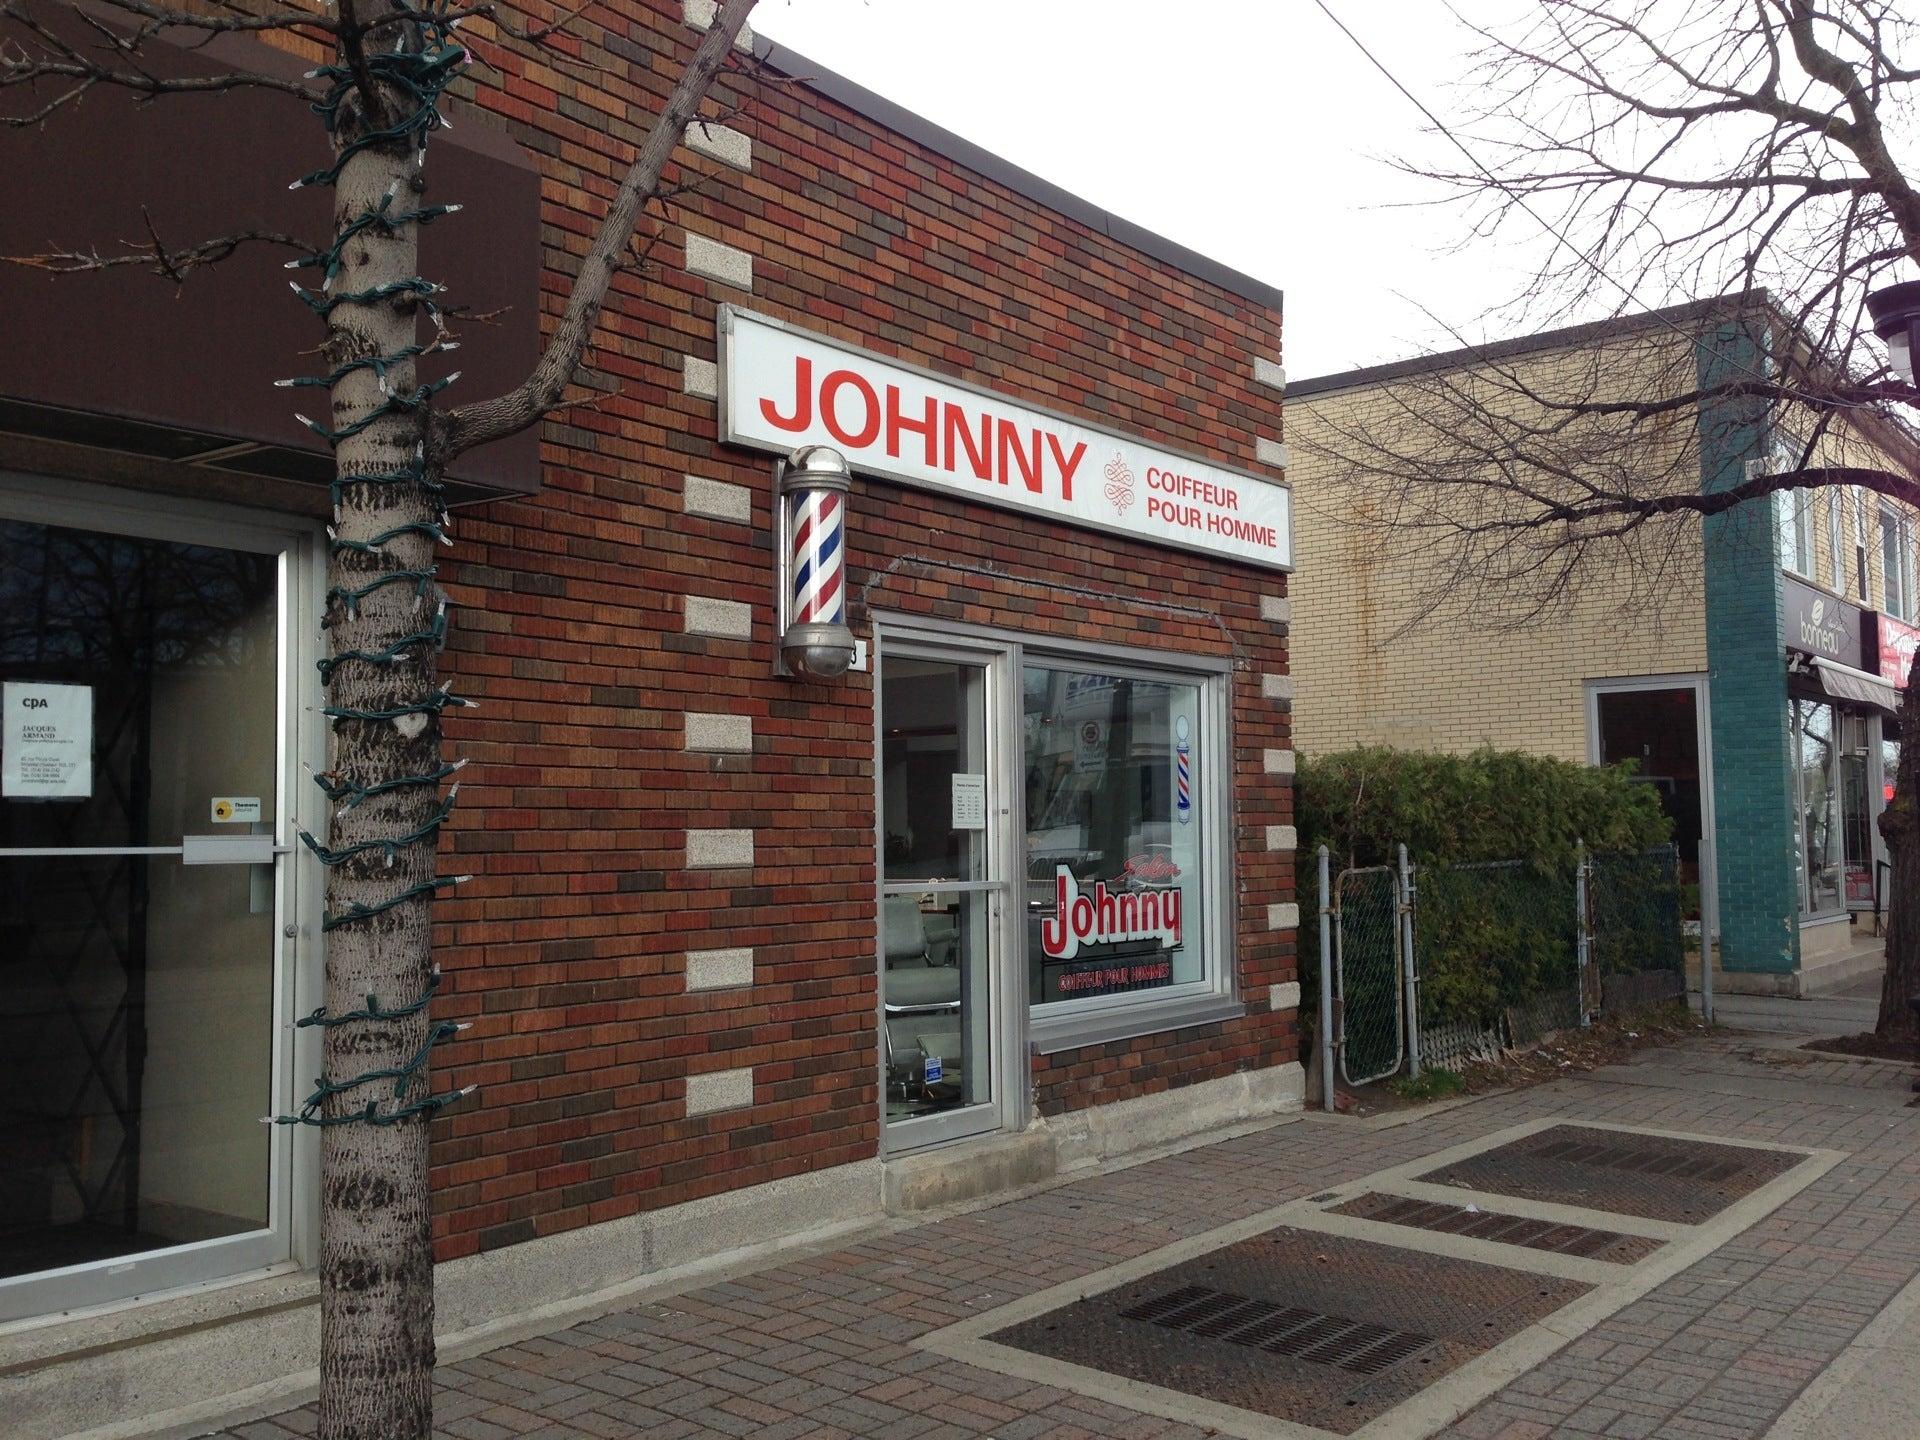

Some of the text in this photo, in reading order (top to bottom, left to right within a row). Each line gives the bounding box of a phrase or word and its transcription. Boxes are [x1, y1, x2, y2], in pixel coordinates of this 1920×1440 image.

[759, 355, 1088, 502] JOHNNY
[1146, 467, 1238, 511] COIFFEUR
[1147, 497, 1277, 548] POUR HOMME
[1800, 610, 1839, 654] bonneau
[1042, 863, 1182, 959] Johnny
[1058, 963, 1170, 992] COIFFEUR POUR HOMMES
